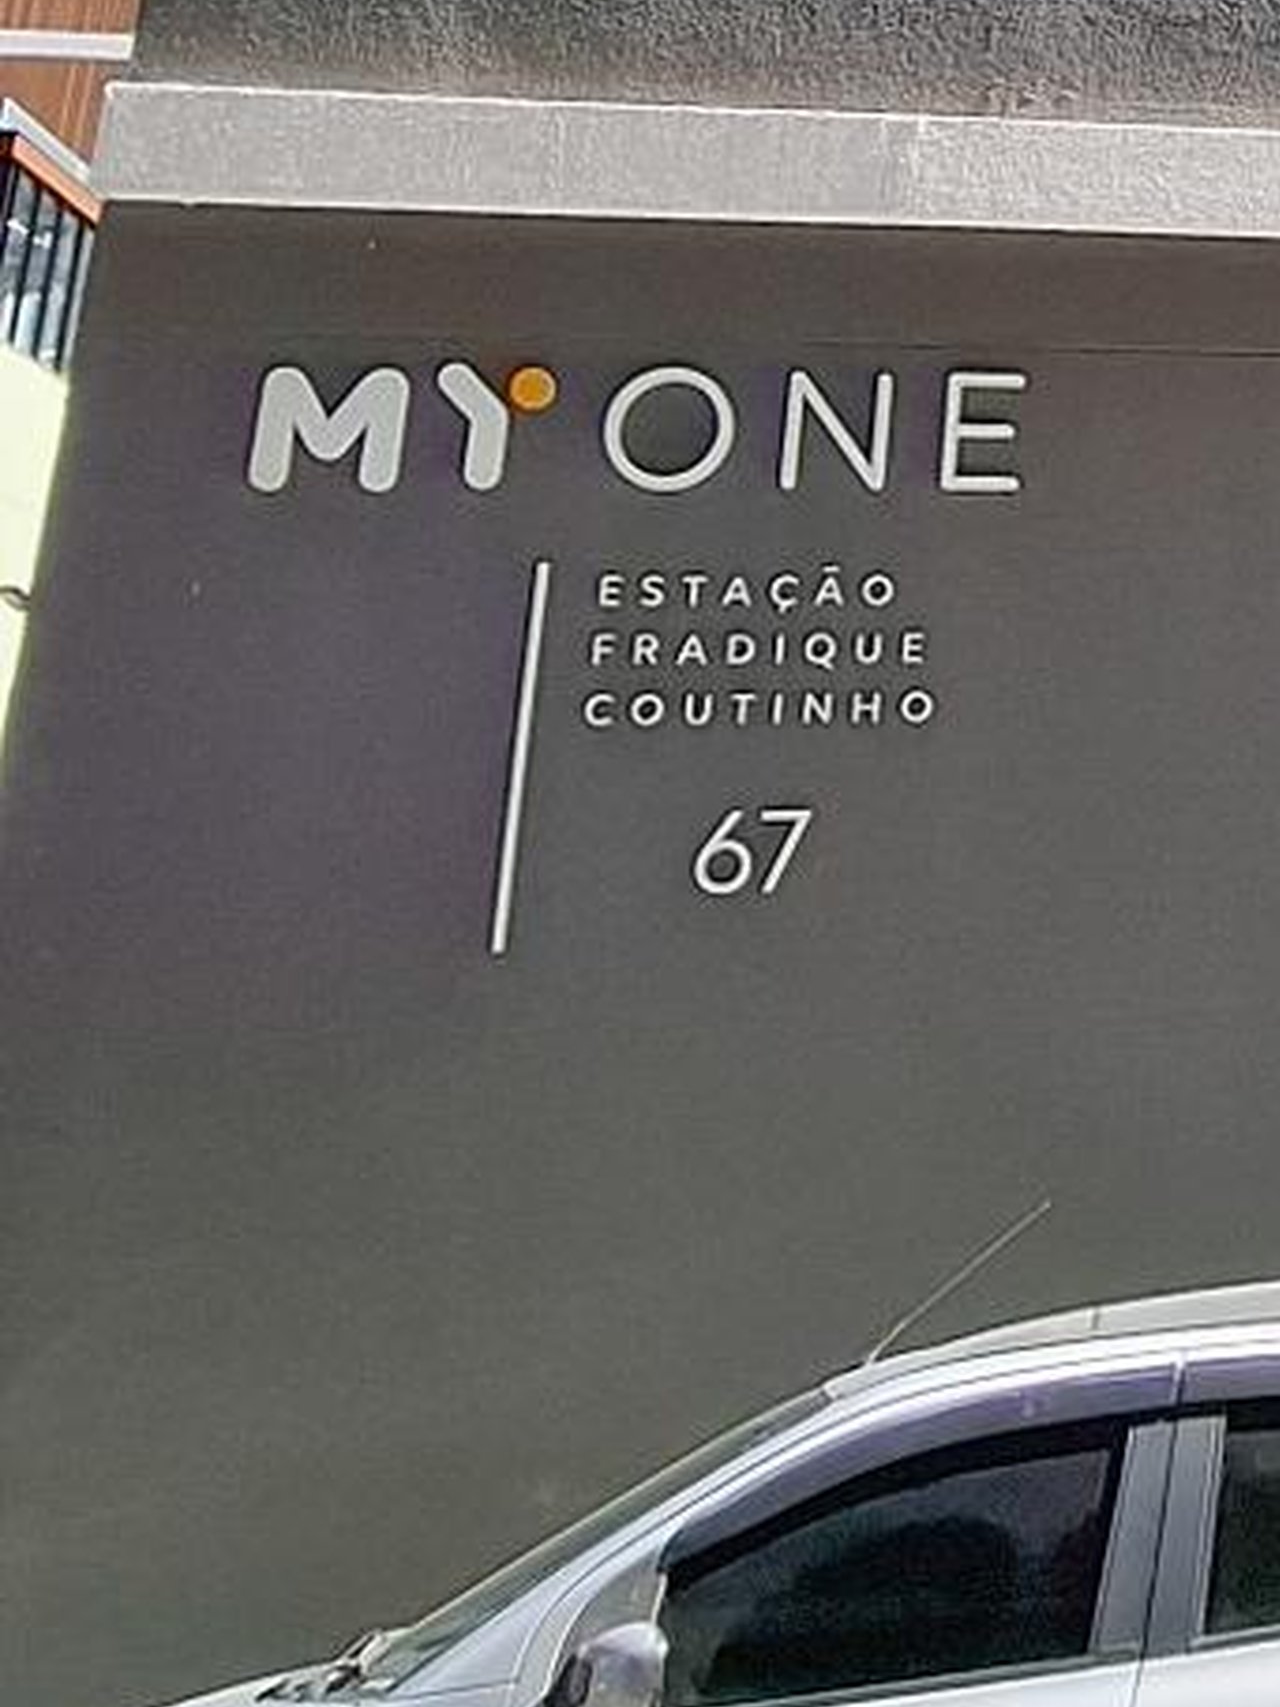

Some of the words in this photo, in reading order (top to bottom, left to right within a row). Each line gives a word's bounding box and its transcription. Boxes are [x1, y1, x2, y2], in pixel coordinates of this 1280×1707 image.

[602, 364, 1027, 493] ONE
[598, 564, 896, 615] ESTAÇÃO
[590, 631, 926, 671] FRADIQUE
[583, 688, 935, 728] COUTINHO
[692, 808, 813, 895] 67
